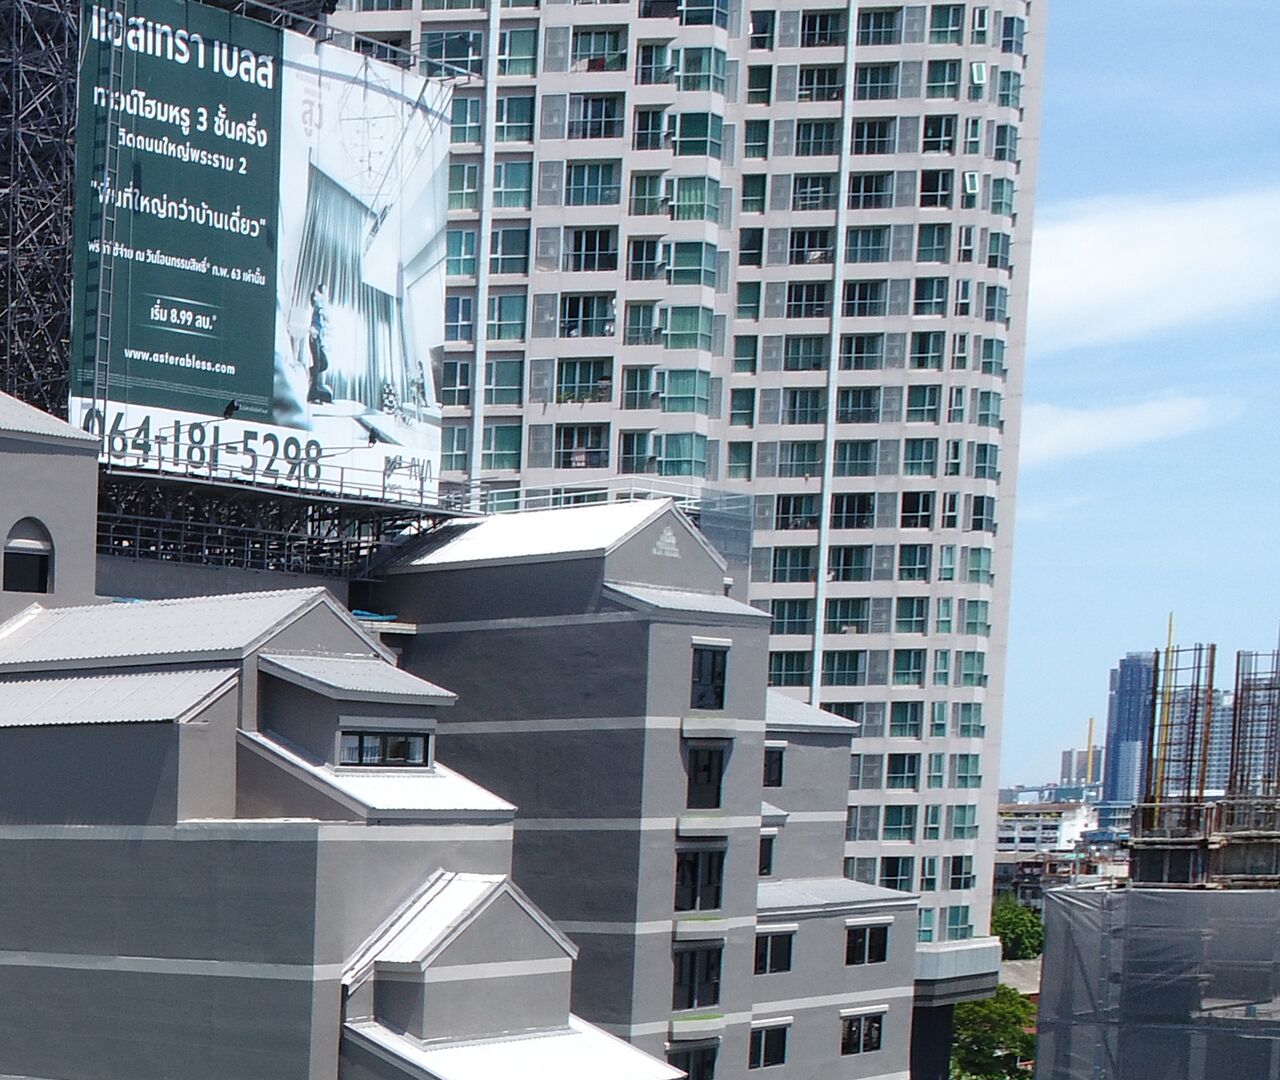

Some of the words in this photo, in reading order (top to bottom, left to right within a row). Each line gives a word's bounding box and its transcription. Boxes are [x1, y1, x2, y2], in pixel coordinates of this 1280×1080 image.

[196, 107, 208, 132] 3
[238, 157, 247, 175] 2
[231, 268, 241, 280] 63
[170, 308, 193, 326] 8.99
[124, 348, 236, 375] www.asterabless.com
[83, 407, 322, 484] 064-181-5298
